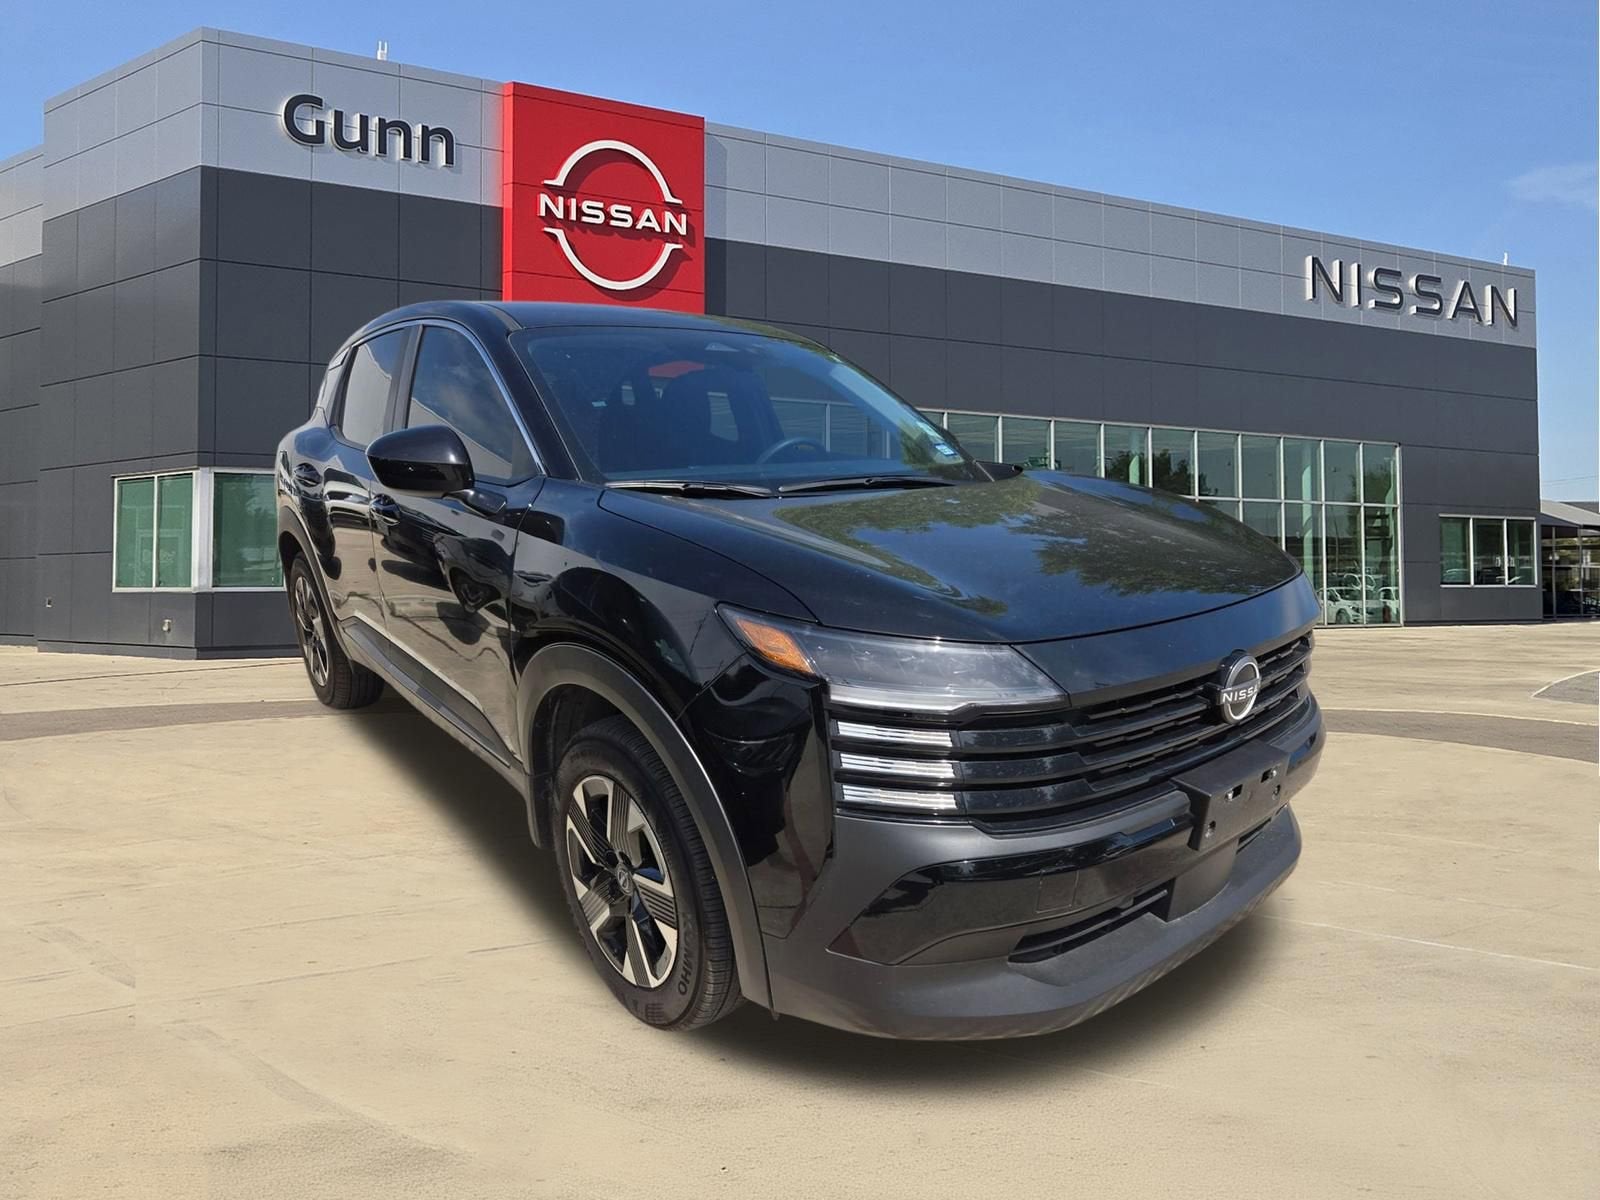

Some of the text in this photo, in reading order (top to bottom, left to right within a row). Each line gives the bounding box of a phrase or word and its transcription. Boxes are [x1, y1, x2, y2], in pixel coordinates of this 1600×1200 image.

[282, 93, 455, 167] Gunn
[537, 192, 687, 236] NISSAN
[1305, 255, 1518, 327] NISSAN
